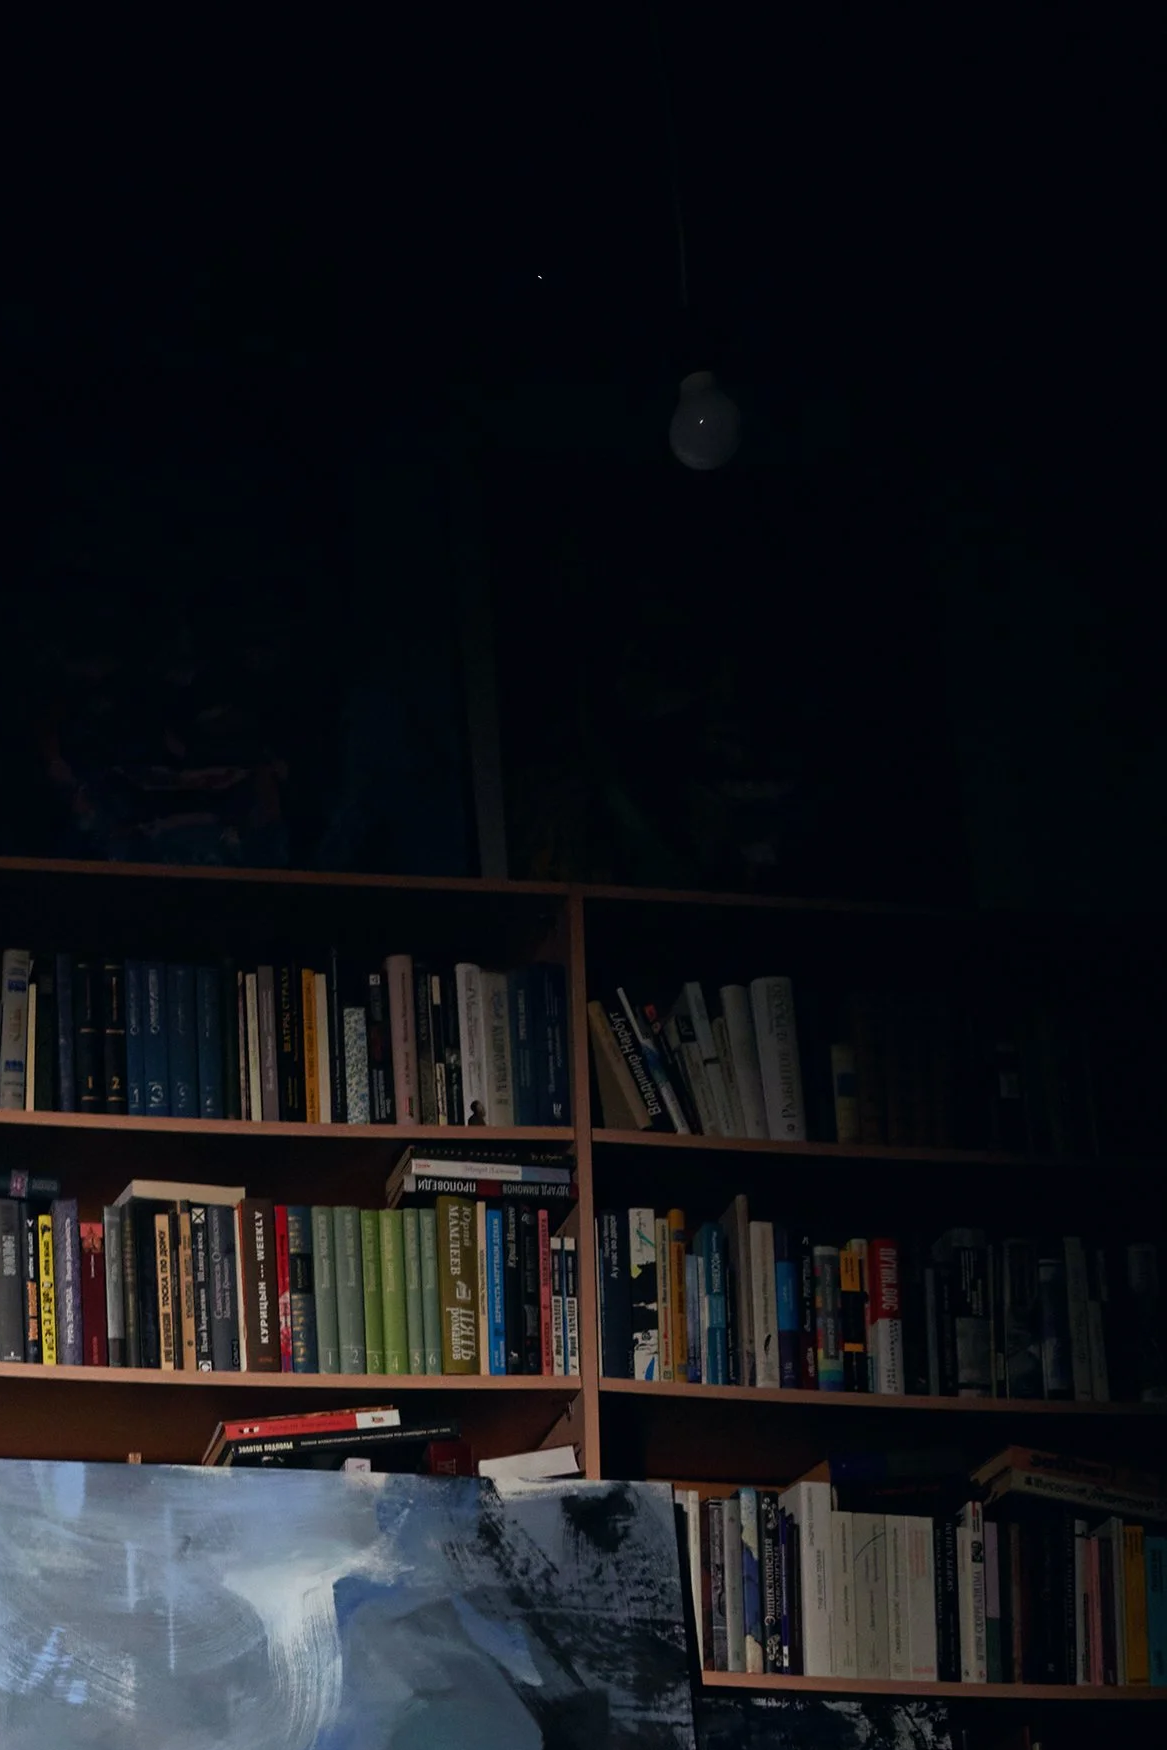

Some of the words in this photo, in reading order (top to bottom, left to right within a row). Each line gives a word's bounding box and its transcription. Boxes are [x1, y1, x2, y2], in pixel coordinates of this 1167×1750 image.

[281, 966, 291, 1010] СТРАХА
[609, 1011, 634, 1056] Нарбут
[150, 1084, 164, 1103] 3
[628, 1055, 663, 1117] Владимир
[417, 1178, 476, 1193] ПРОПОВЕДИ
[502, 1184, 540, 1197] ЛИМОНОВ
[541, 1184, 570, 1197] ЭДУАРД
[158, 1230, 168, 1256] ДОМУ
[254, 1211, 266, 1261] WEEKLY
[448, 1203, 462, 1276] МАМЛЕЕВ
[461, 1205, 473, 1247] Юрий
[609, 1214, 618, 1240] дворе
[160, 1261, 168, 1273] ПО
[879, 1247, 900, 1312] ПУТИН.DOC
[161, 1277, 170, 1306] ТОСКА
[494, 1287, 502, 1323] ВЕРНОСТЬ
[258, 1282, 270, 1344] КУРИЦЫН
[552, 1298, 563, 1332] МАМЛЕЕВ
[566, 1299, 577, 1333] МАМЛЕЕВ
[445, 1307, 462, 1360] романов
[460, 1310, 476, 1361] ПЯТЬ
[553, 1333, 562, 1357] Юрий
[568, 1334, 577, 1358] Юрий
[238, 1444, 262, 1458] ЗОЛОТОЕ
[263, 1441, 294, 1455] ПОДПОЛЬЕ
[763, 1537, 778, 1627] Энциклопедия
